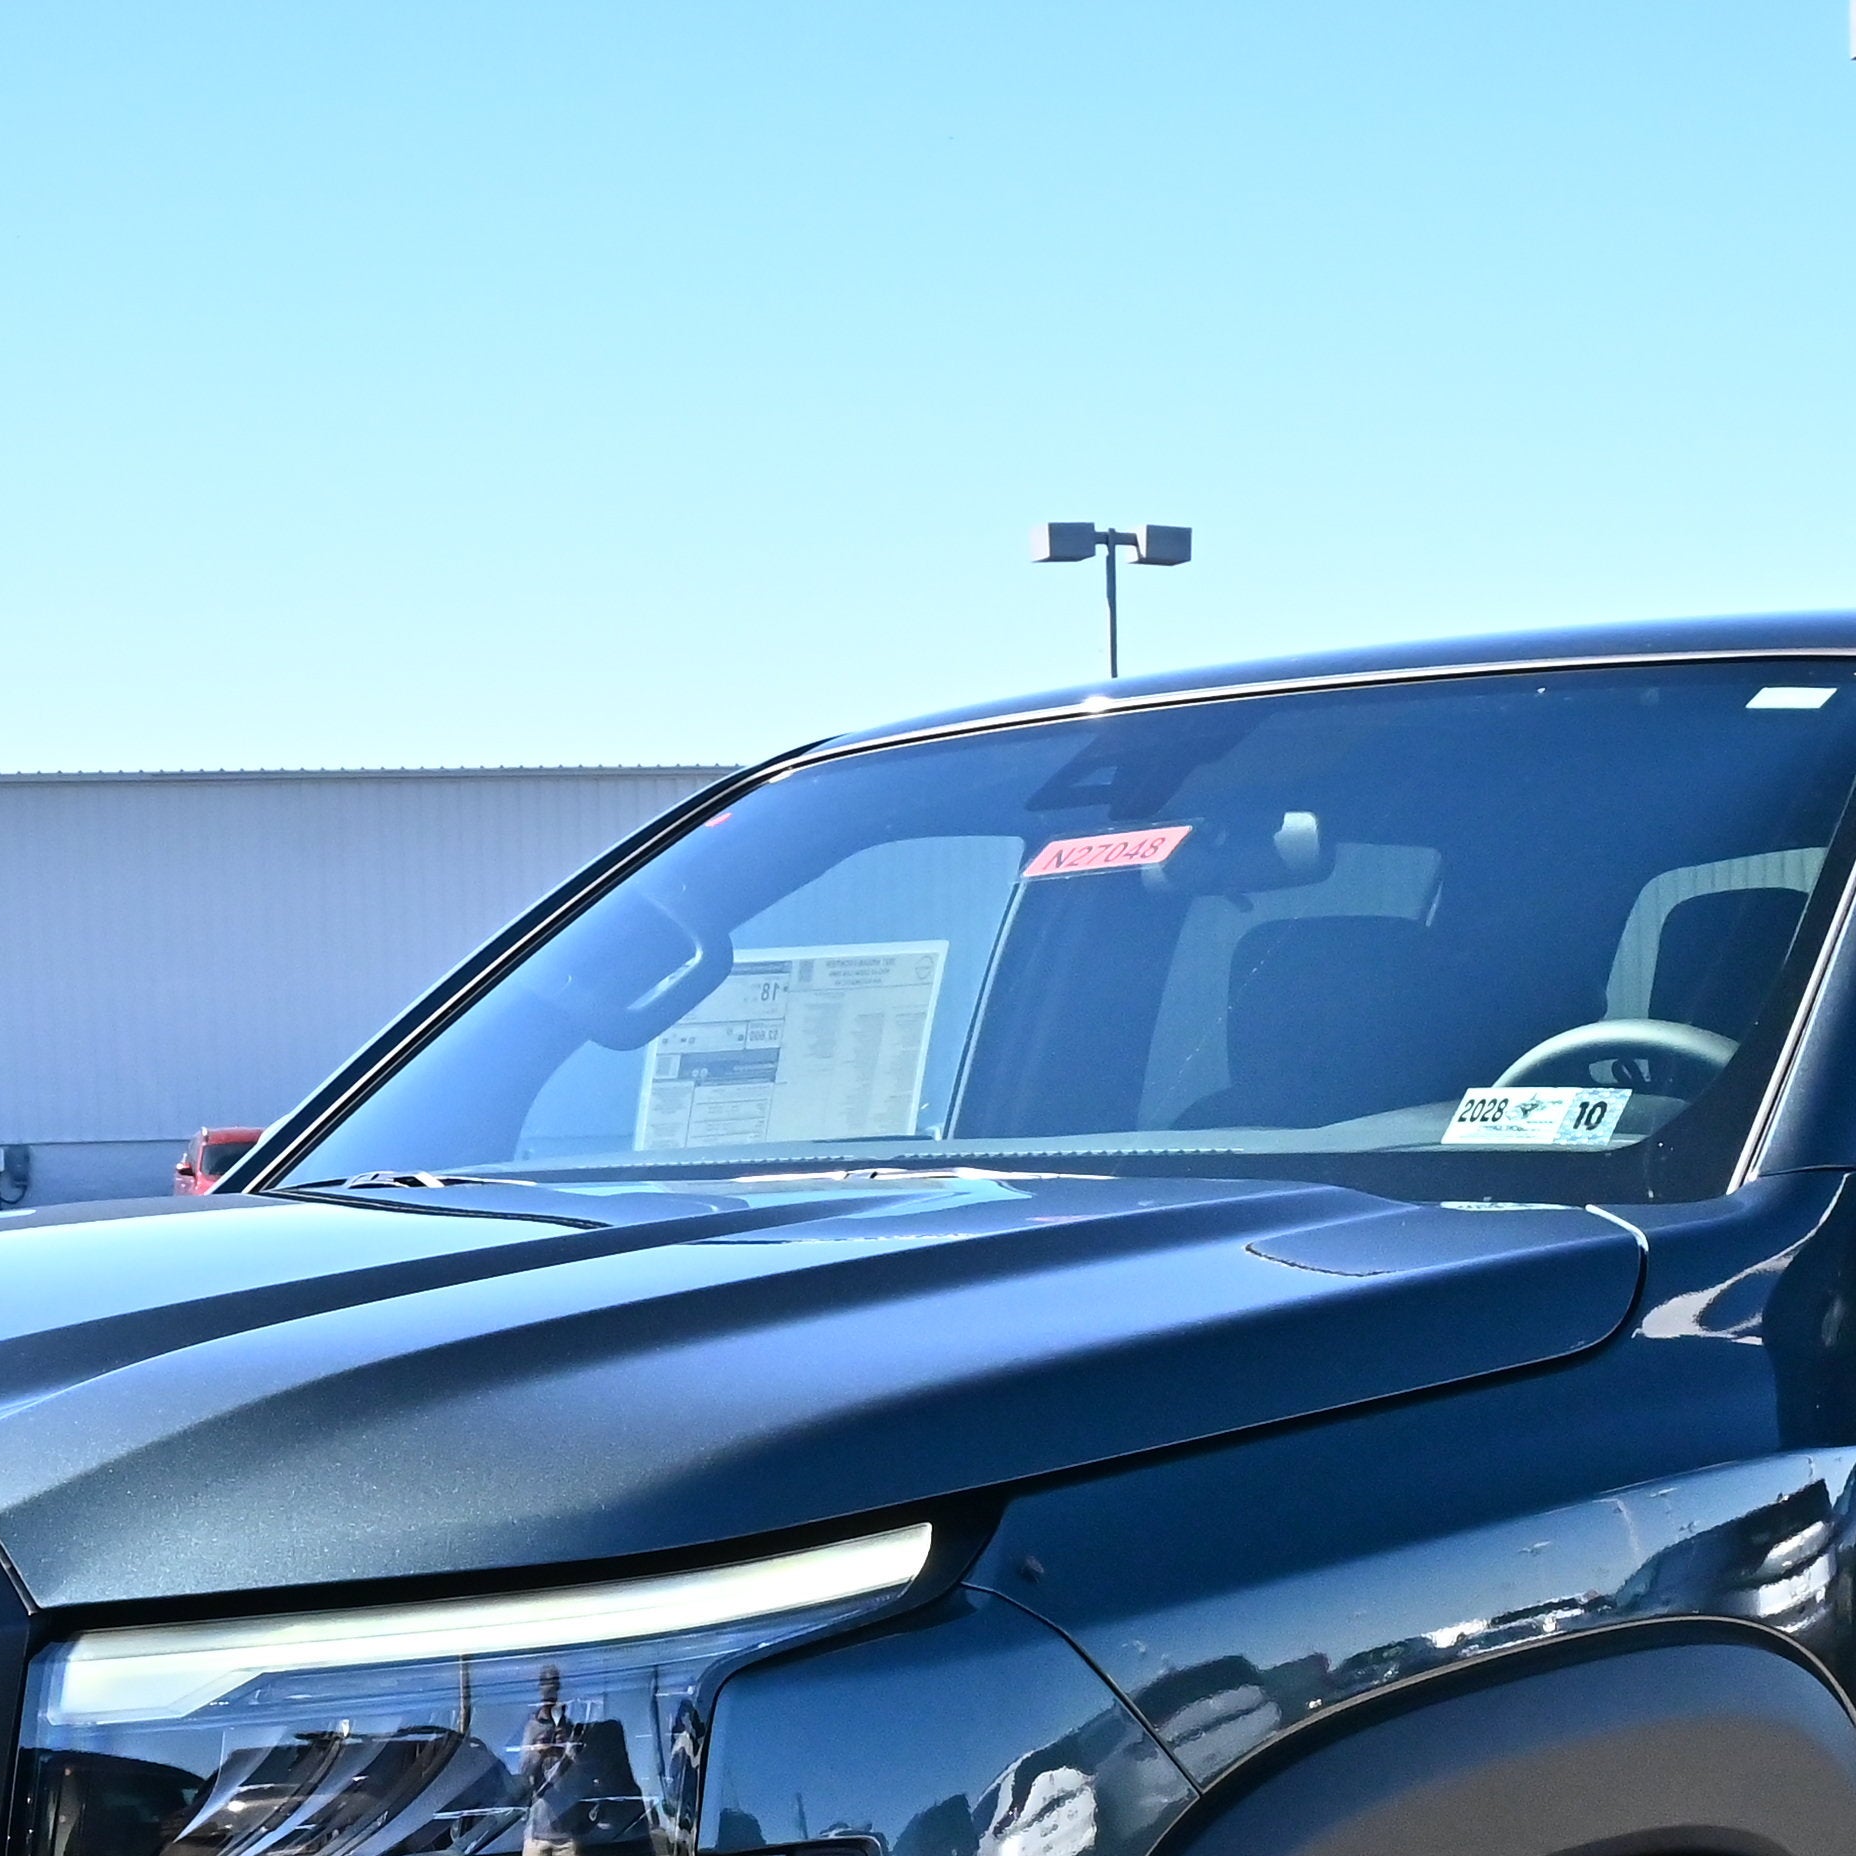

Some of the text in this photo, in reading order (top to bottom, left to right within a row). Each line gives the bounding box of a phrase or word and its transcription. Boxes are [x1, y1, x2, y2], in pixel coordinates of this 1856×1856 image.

[1043, 836, 1166, 871] N27048
[1457, 1098, 1509, 1123] 2028
[1573, 1100, 1608, 1131] 10
